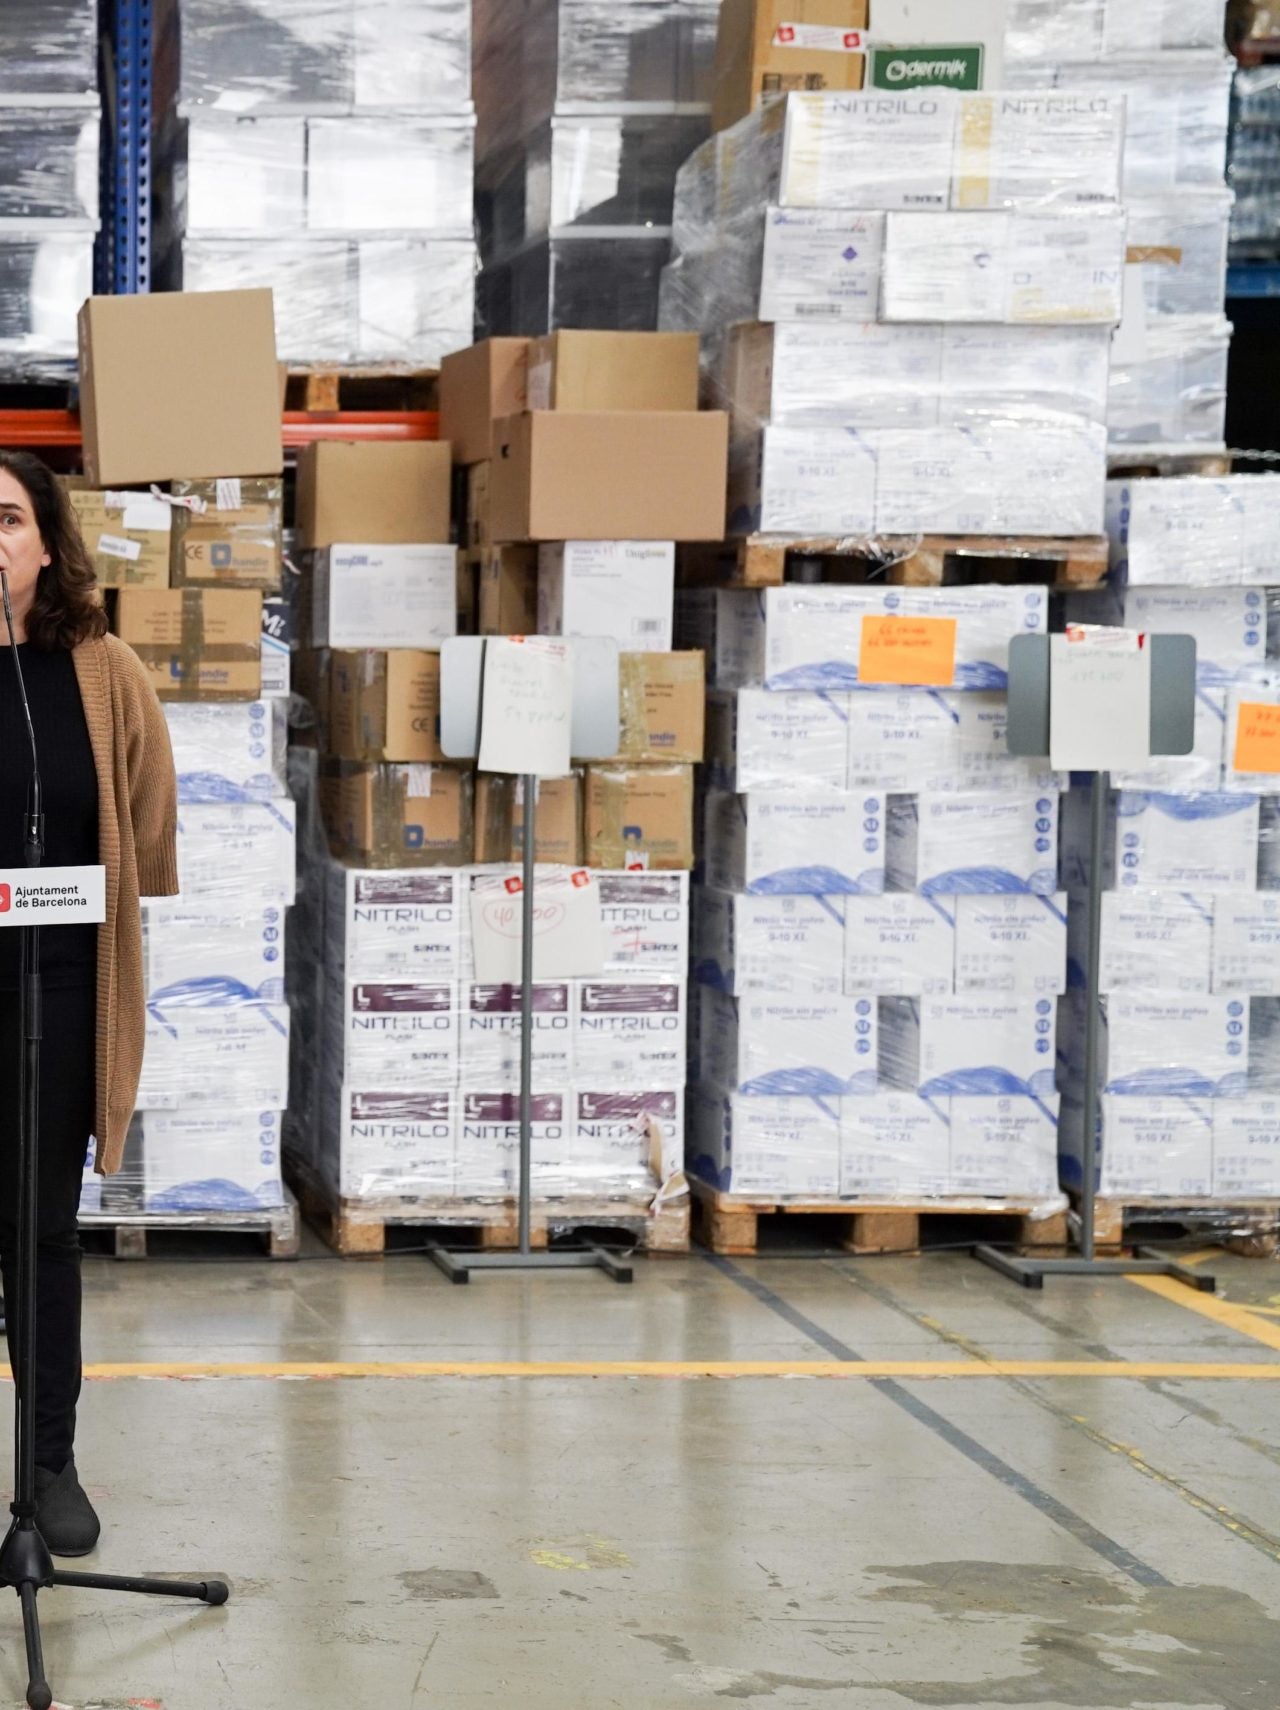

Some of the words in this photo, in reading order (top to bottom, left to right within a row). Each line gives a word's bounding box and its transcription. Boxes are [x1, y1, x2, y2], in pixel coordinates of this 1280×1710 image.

[832, 99, 938, 115] NITRILO
[15, 886, 79, 898] Ajuntament
[15, 899, 29, 908] de
[31, 896, 87, 908] Barcelona
[354, 908, 453, 922] NITRILO
[600, 908, 680, 921] ITRILO
[470, 1017, 569, 1030] NITRLO
[580, 1017, 678, 1030] NITRILO
[351, 1125, 449, 1138] NITRILO
[463, 1126, 562, 1139] NITRLO
